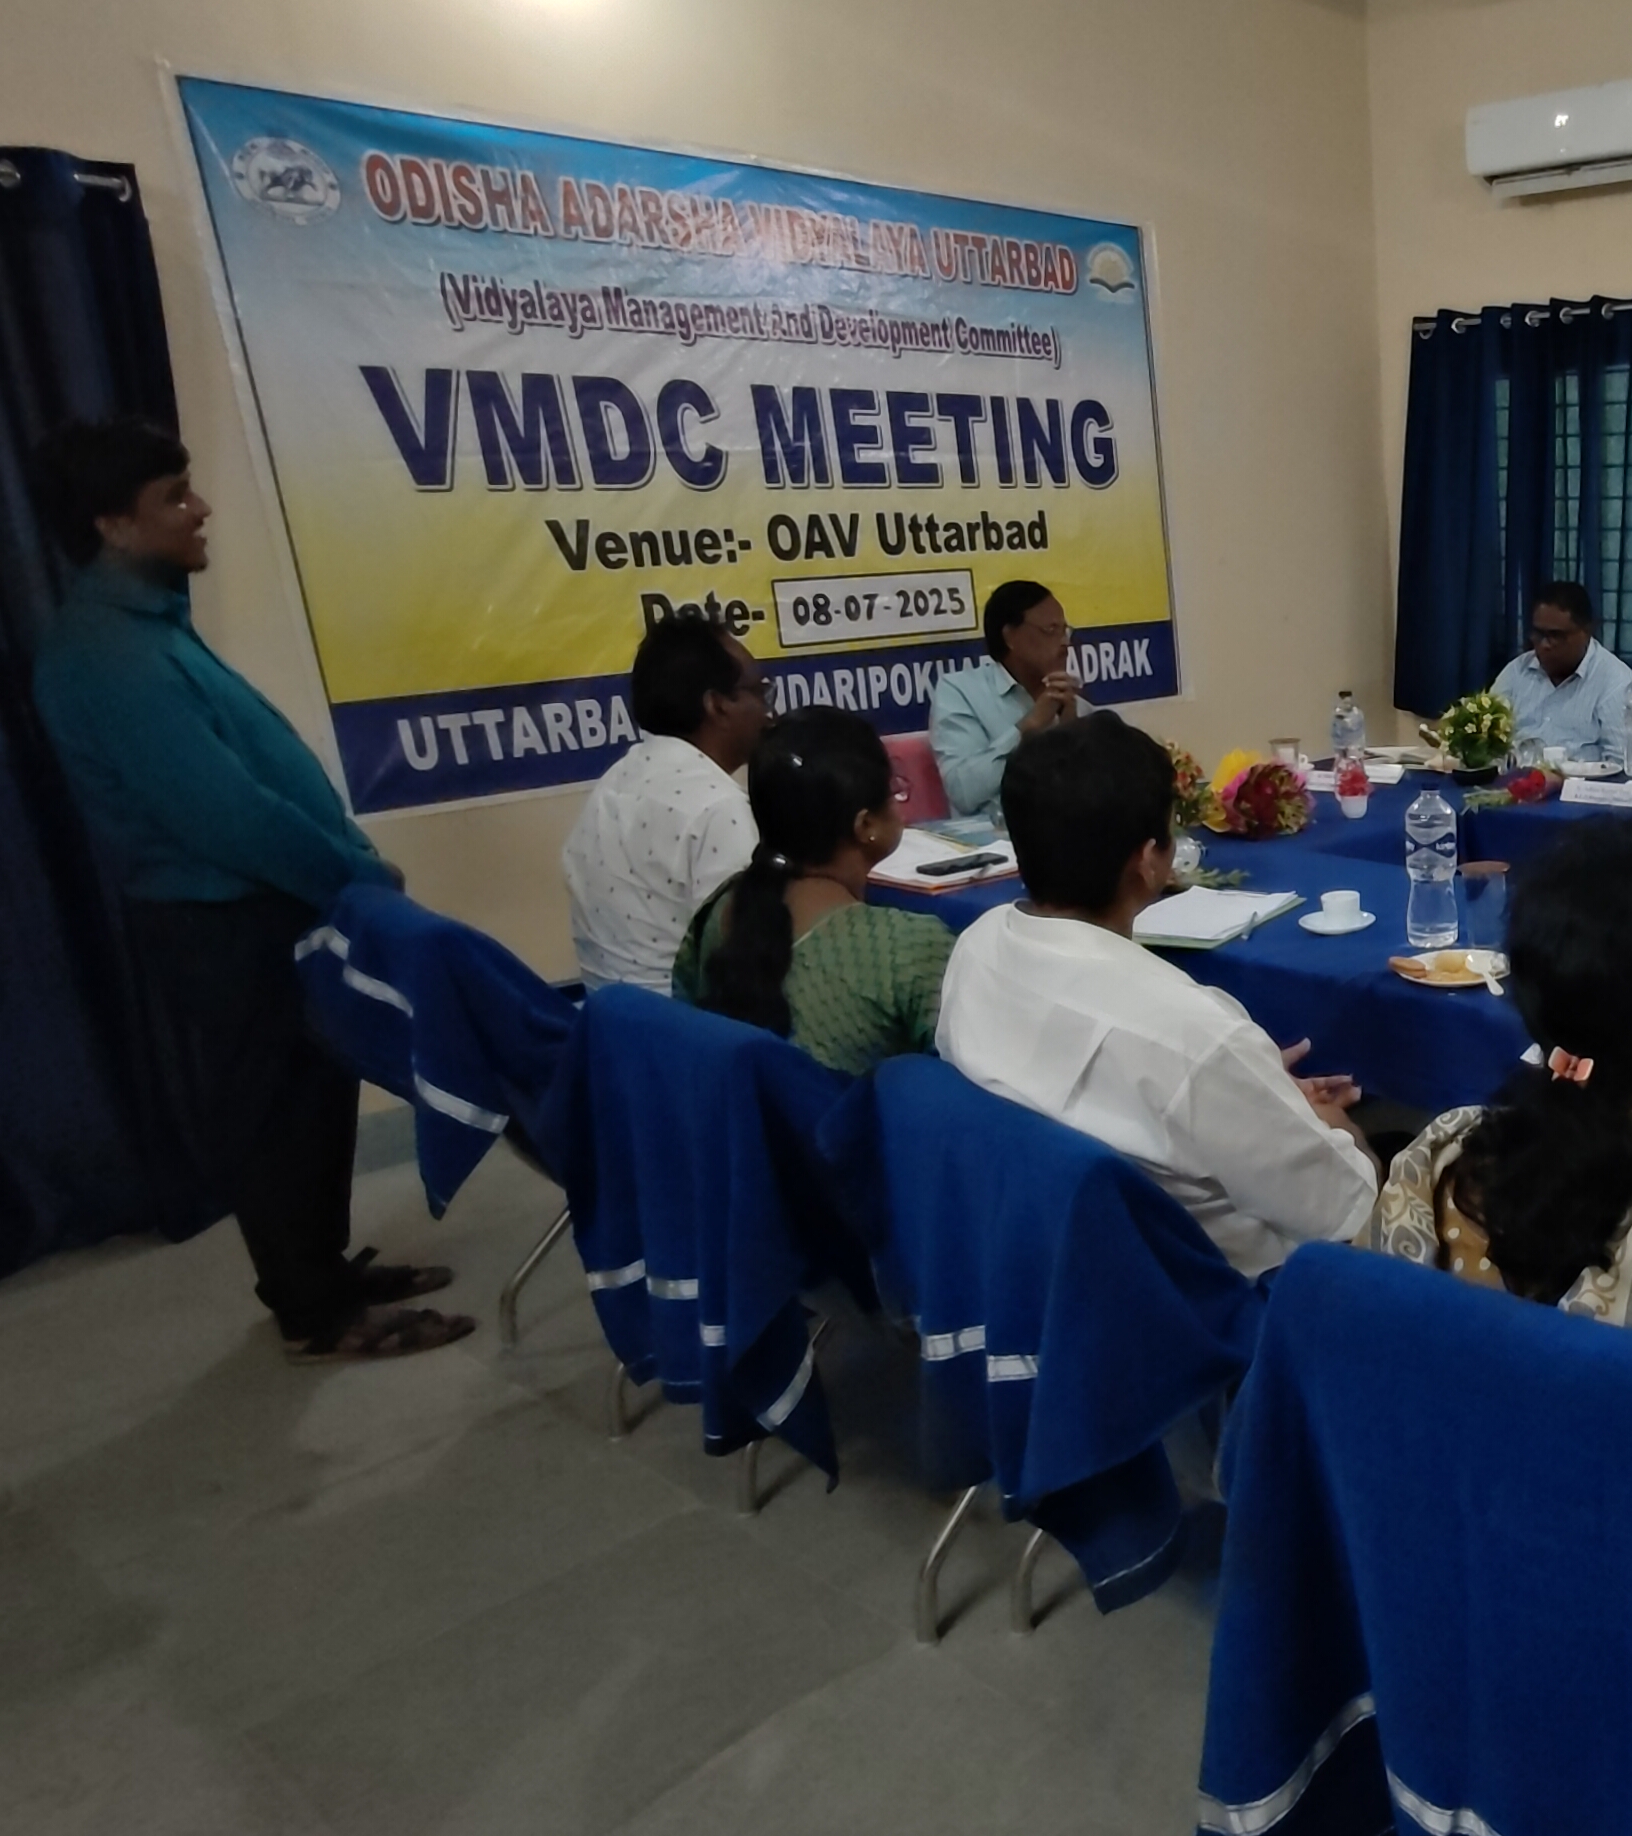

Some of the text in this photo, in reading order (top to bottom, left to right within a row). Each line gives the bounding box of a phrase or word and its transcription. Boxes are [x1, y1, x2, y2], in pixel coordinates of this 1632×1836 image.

[362, 150, 555, 237] ODISHA
[558, 176, 745, 257] ADARSHA
[930, 228, 1078, 295] UTTARBAD
[440, 271, 1061, 369] (Vidyalaya Management And Development Committee)
[358, 365, 1119, 491] VMDC MEETING
[545, 510, 1049, 571] Venue:- OAV Uttarbad
[397, 695, 644, 771] UTTARBA
[1066, 638, 1154, 688] ADRAK
